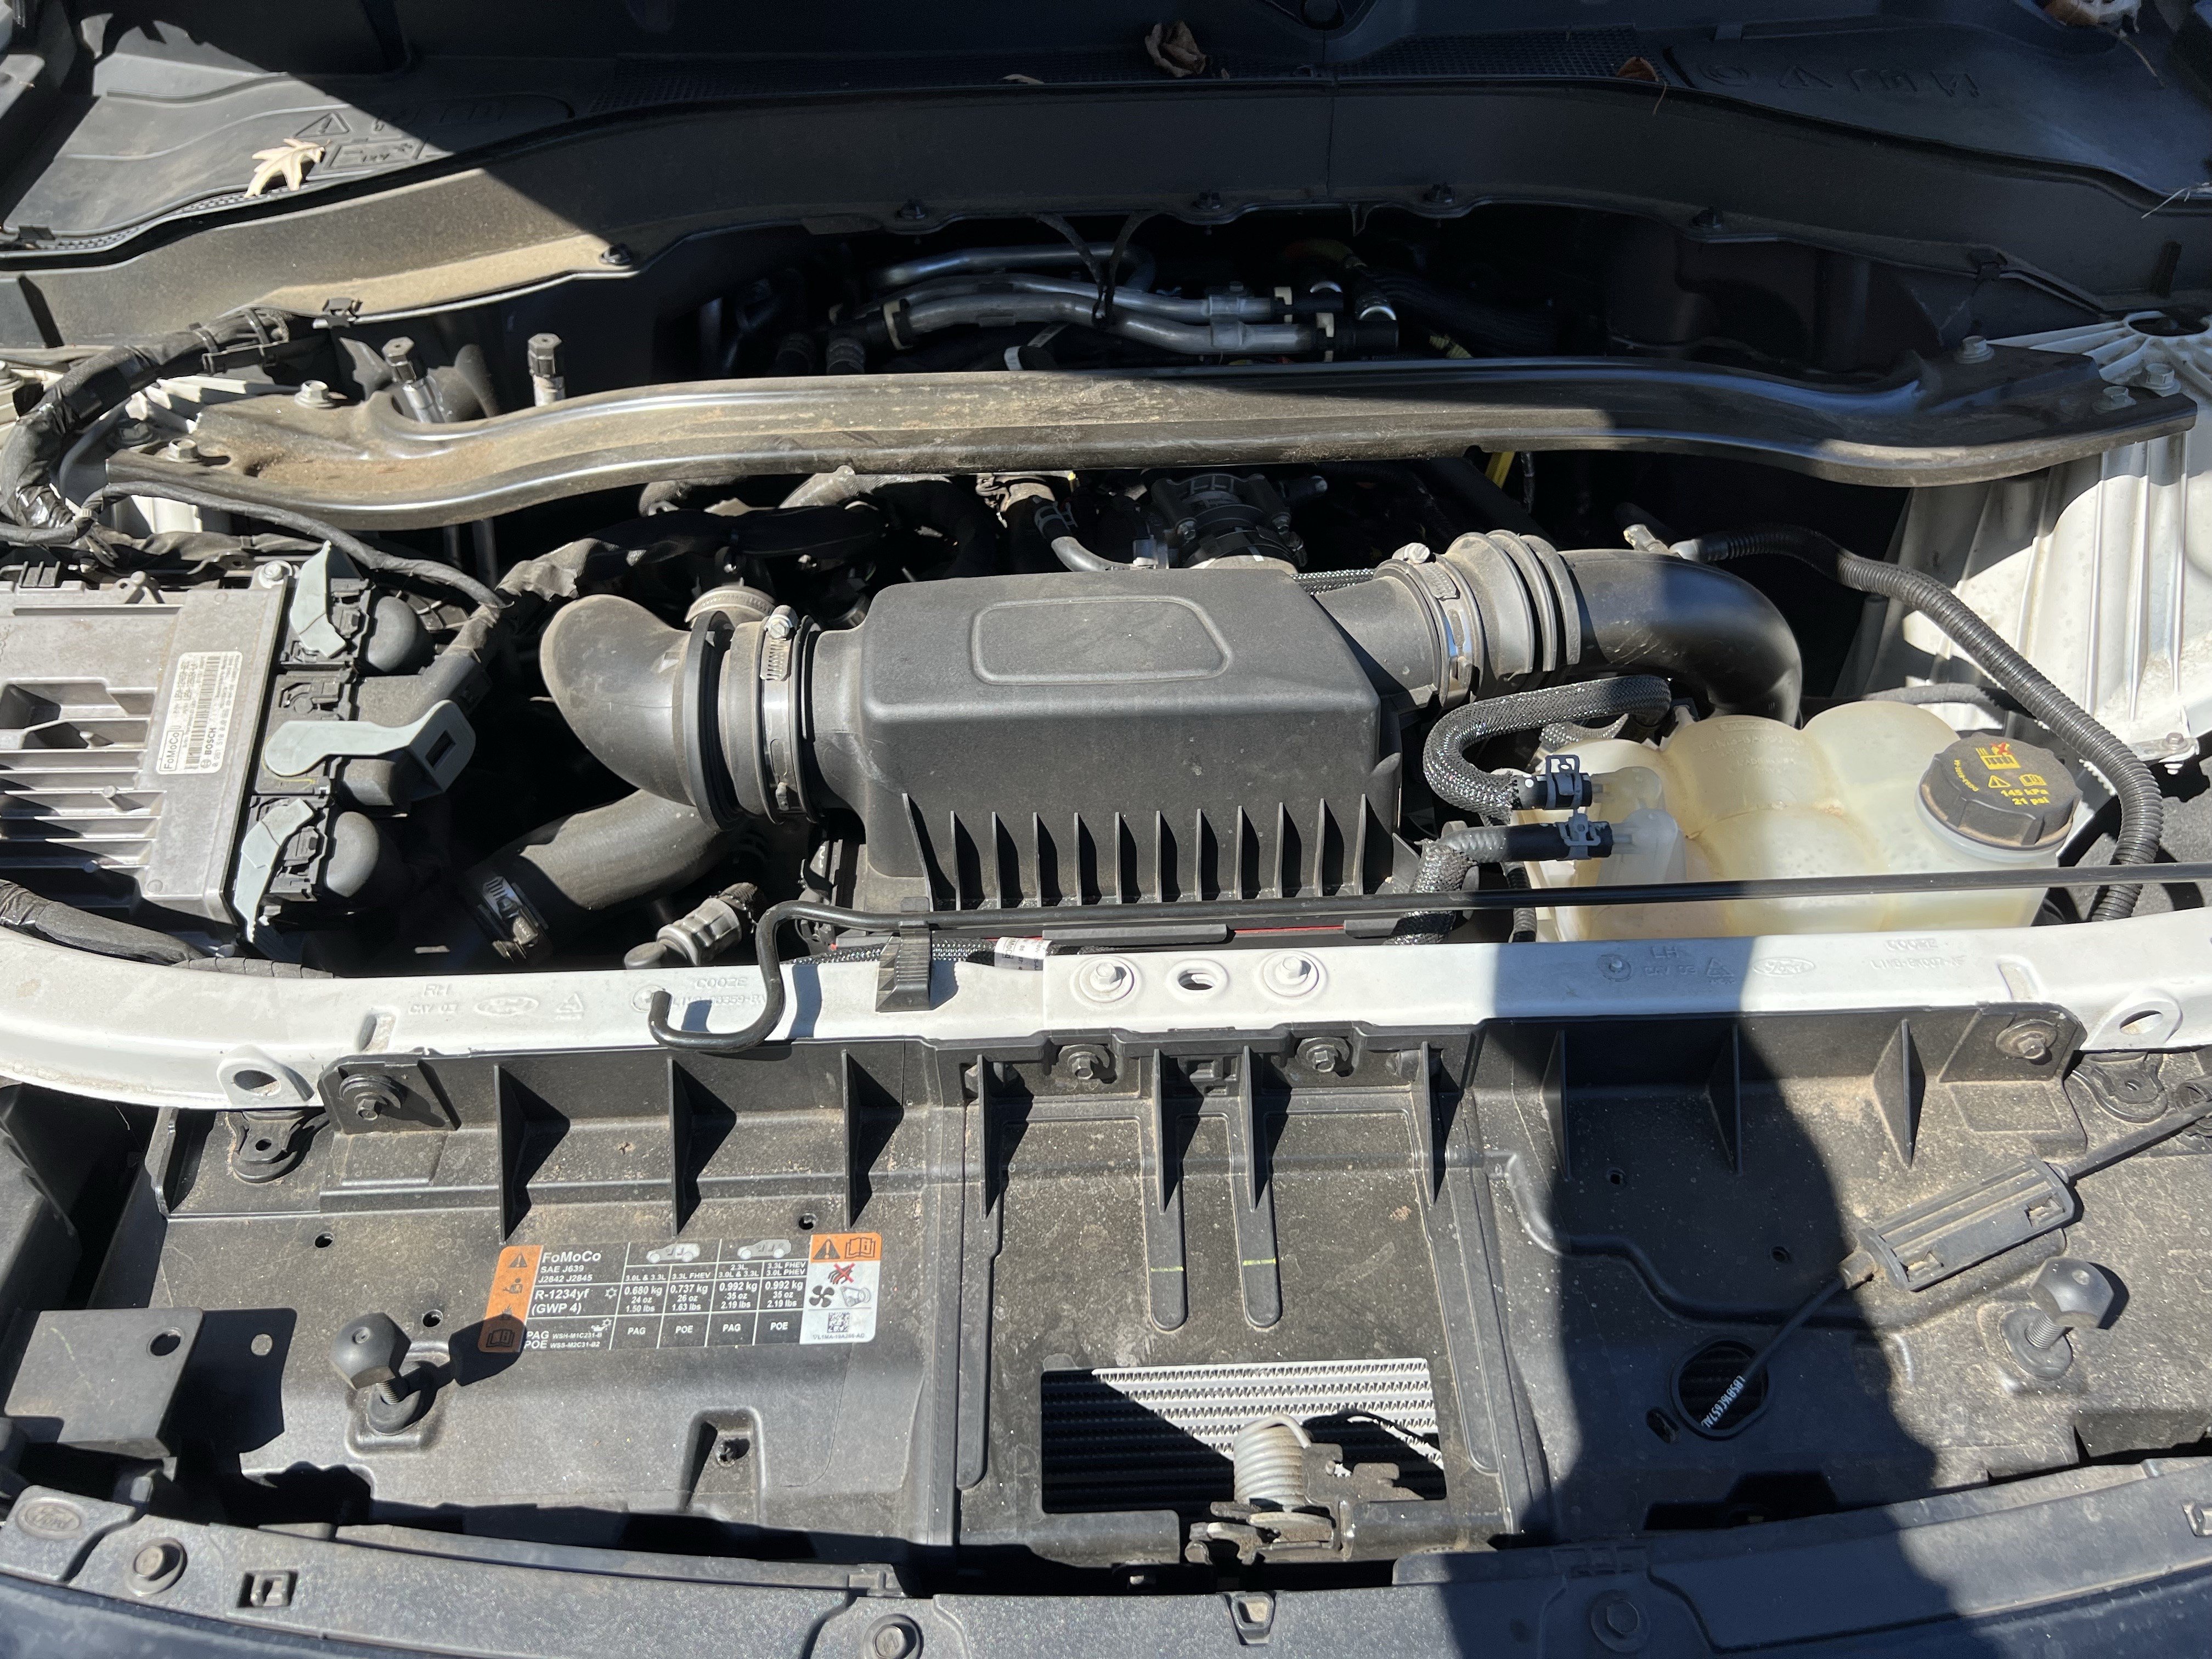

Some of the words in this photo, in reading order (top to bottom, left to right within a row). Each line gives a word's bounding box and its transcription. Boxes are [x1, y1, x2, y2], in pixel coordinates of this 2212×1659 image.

[205, 727, 217, 755] BOSCH
[163, 732, 179, 769] FoMoCo
[2000, 789, 2024, 797] 145
[2012, 797, 2028, 805] 21
[2030, 797, 2050, 806] psi
[1649, 946, 1679, 959] LH
[422, 983, 453, 997] RH
[542, 1251, 602, 1263] FoMoCo
[566, 1274, 592, 1282] J2845
[624, 1286, 649, 1295] 0.680
[651, 1285, 663, 1296] kg
[670, 1284, 695, 1294] 0.737
[696, 1284, 708, 1295] kg
[719, 1282, 744, 1291] 0.992
[746, 1282, 758, 1293] kg
[765, 1280, 789, 1290] 0.992
[792, 1280, 803, 1291] kg
[534, 1288, 590, 1301] R-1234yf
[532, 1303, 568, 1316] (GWP
[569, 1302, 582, 1314] 4)
[767, 1300, 783, 1308] 2.19
[675, 1325, 693, 1334] POE
[723, 1323, 741, 1332] PAG
[770, 1322, 788, 1330] POE
[527, 1330, 549, 1340] PAG
[524, 1340, 548, 1349] POE
[32, 1506, 75, 1530] Ford
